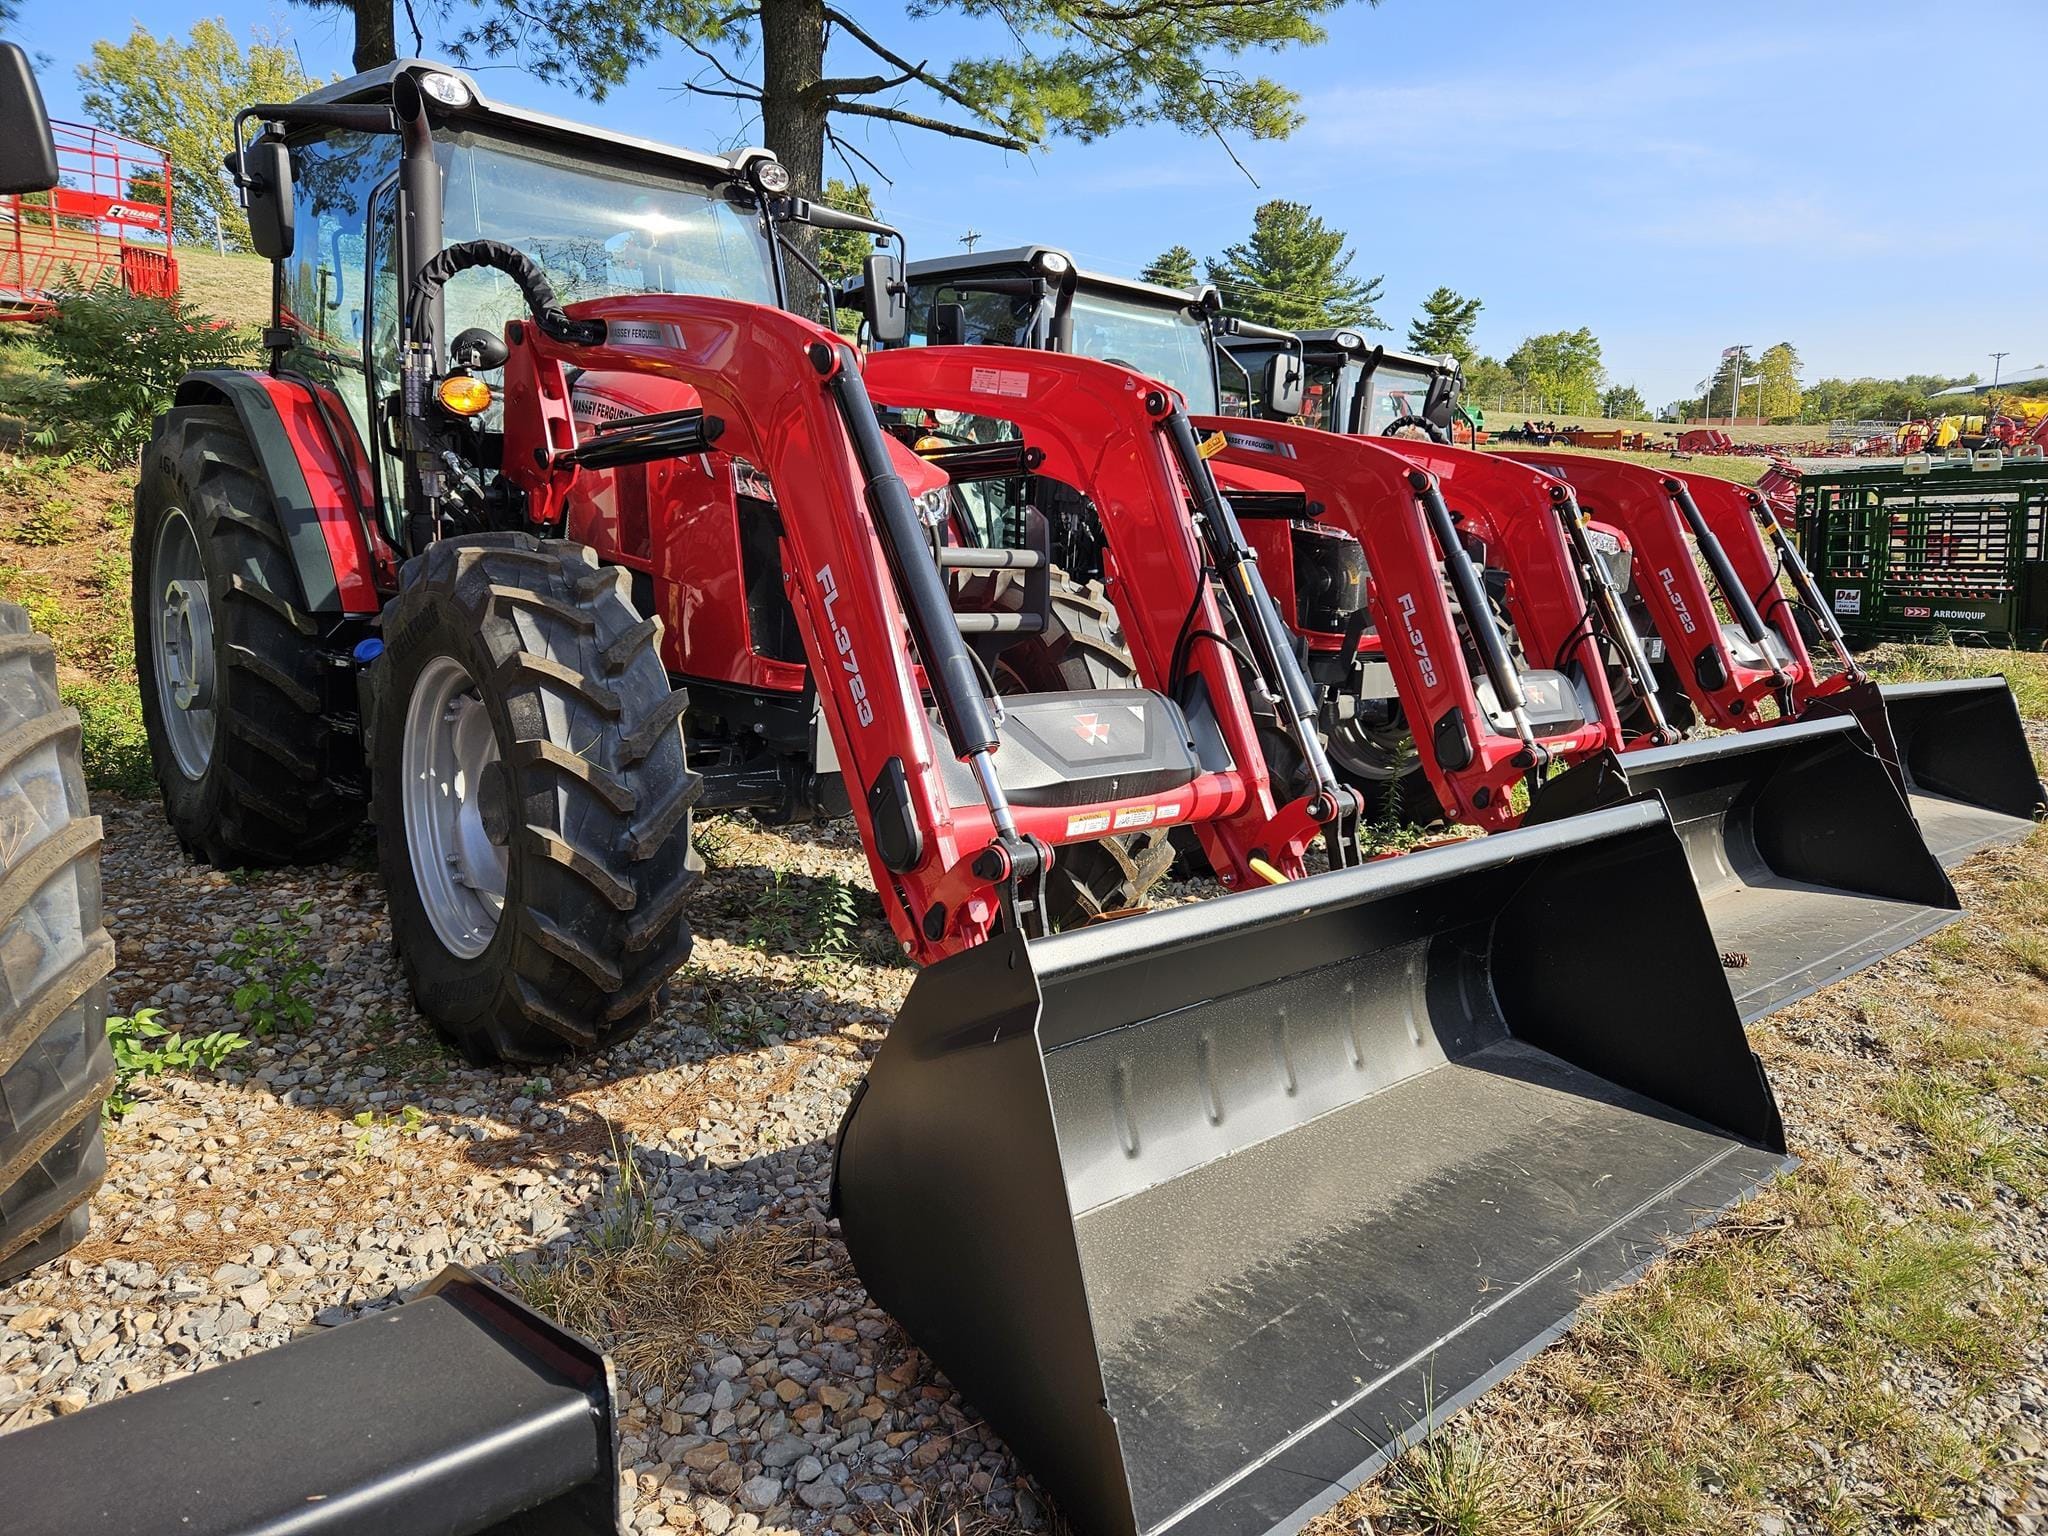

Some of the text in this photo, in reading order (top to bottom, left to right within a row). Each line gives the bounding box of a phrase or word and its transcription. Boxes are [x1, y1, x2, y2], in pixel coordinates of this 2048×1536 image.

[632, 328, 662, 340] FERGUSON
[573, 399, 597, 416] MASSEY
[1245, 439, 1274, 450] FERGUSON
[1658, 567, 1696, 634] FL.3723
[1933, 610, 1986, 620] ARROWQUIP
[815, 563, 874, 728] FL.3723
[1397, 593, 1438, 688] FL.3723
